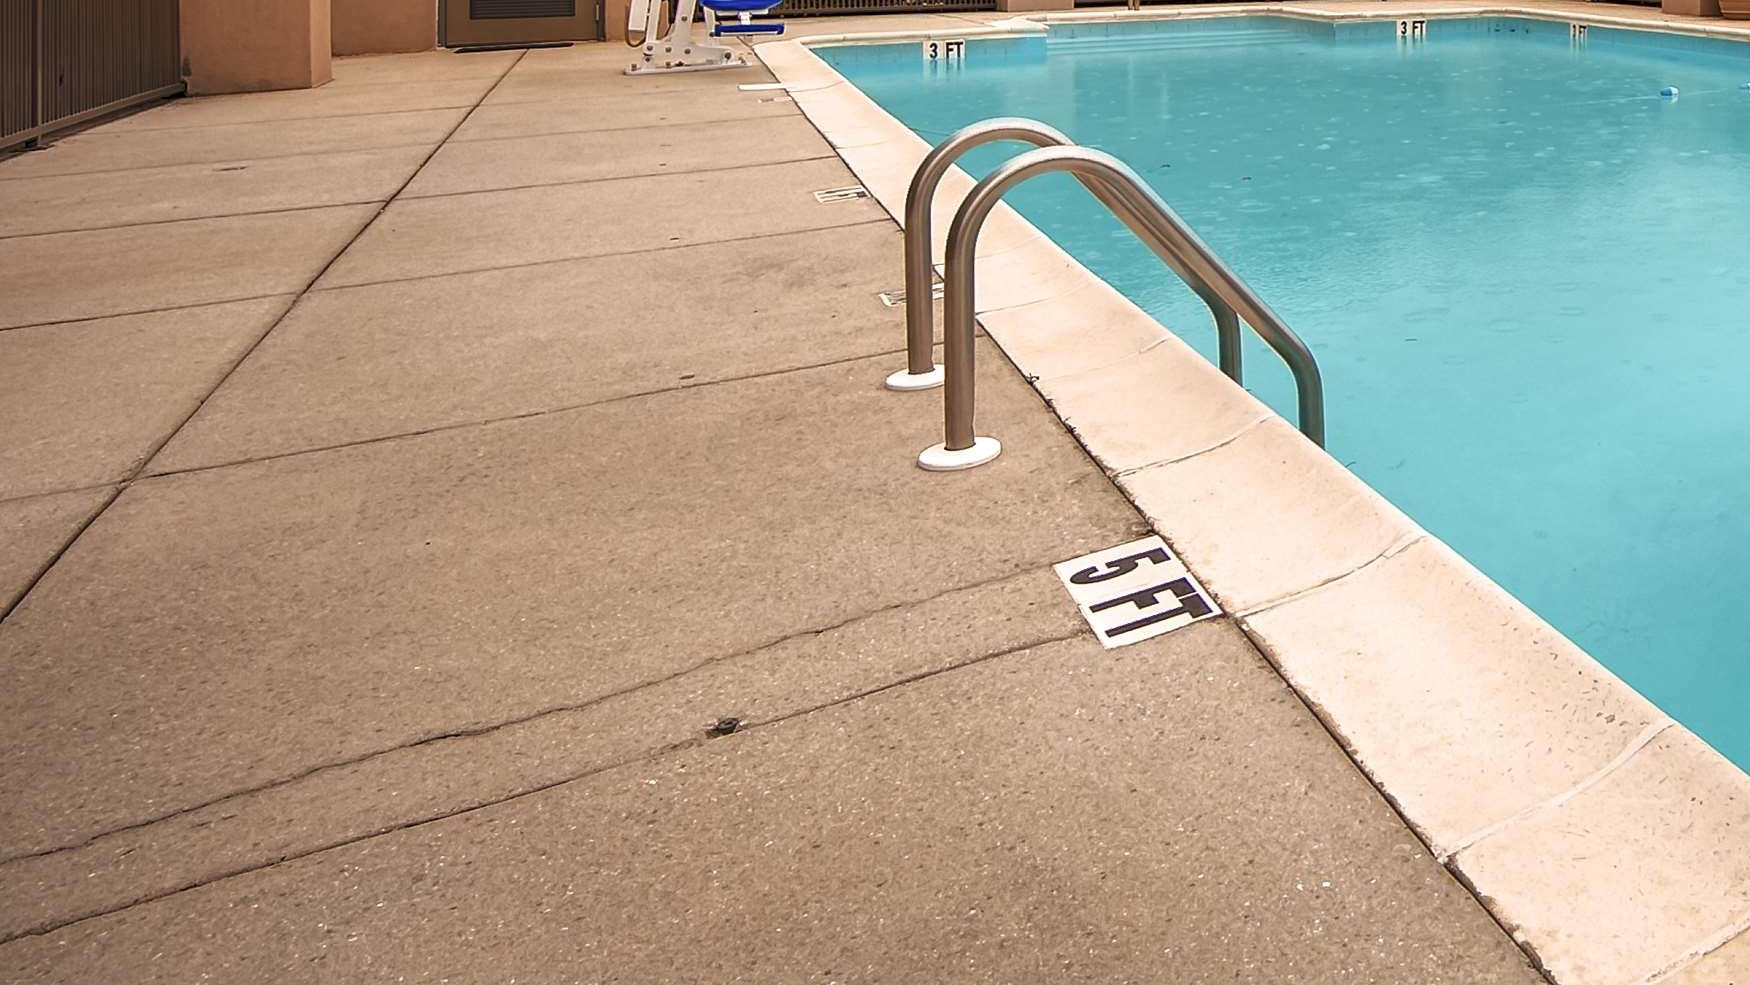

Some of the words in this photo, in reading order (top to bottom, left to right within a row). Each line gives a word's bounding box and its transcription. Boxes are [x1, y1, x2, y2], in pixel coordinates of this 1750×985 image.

[1400, 20, 1408, 35] 3
[1412, 20, 1425, 35] FT
[929, 42, 938, 59] 3
[945, 41, 963, 59] FT
[1069, 547, 1171, 584] 5
[1089, 577, 1213, 638] FT
